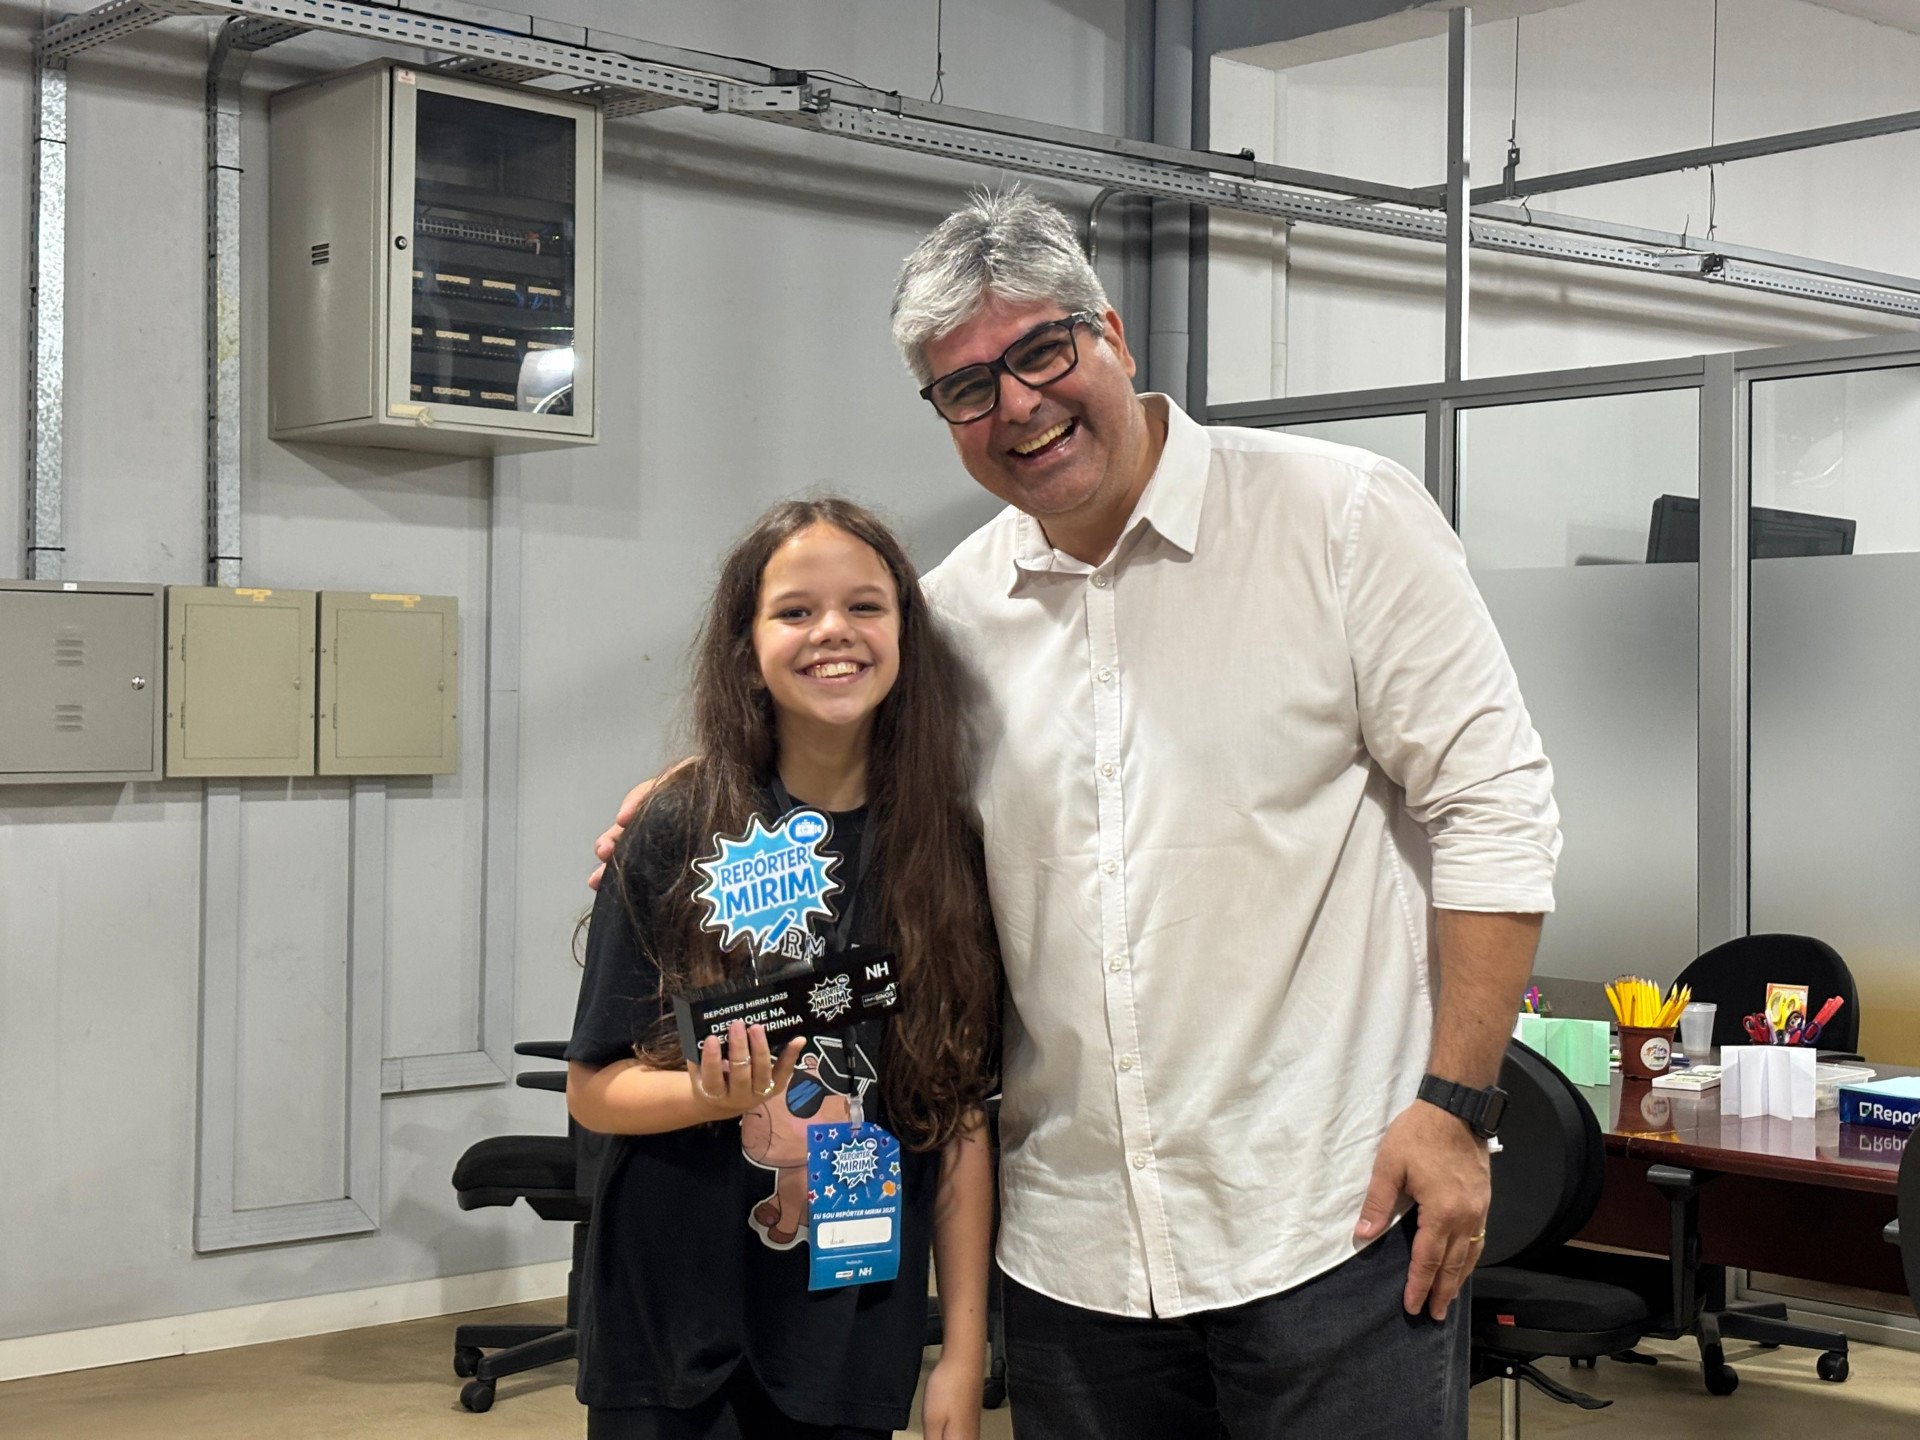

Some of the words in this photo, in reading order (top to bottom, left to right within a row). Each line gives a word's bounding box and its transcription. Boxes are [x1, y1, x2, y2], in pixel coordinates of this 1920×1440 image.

[720, 846, 808, 887] REPÓRTER
[726, 867, 816, 919] MIRIM
[865, 961, 890, 981] NH
[703, 1003, 745, 1020] REPÓRTER
[746, 997, 770, 1009] MIRIM
[770, 991, 789, 1002] 2025
[815, 992, 846, 1007] MIRIM
[770, 1006, 786, 1018] NA
[840, 1159, 871, 1172] MIRIM
[835, 1209, 864, 1218] REPÓRTER
[882, 1206, 896, 1214] 2025
[858, 1266, 873, 1277] NH
